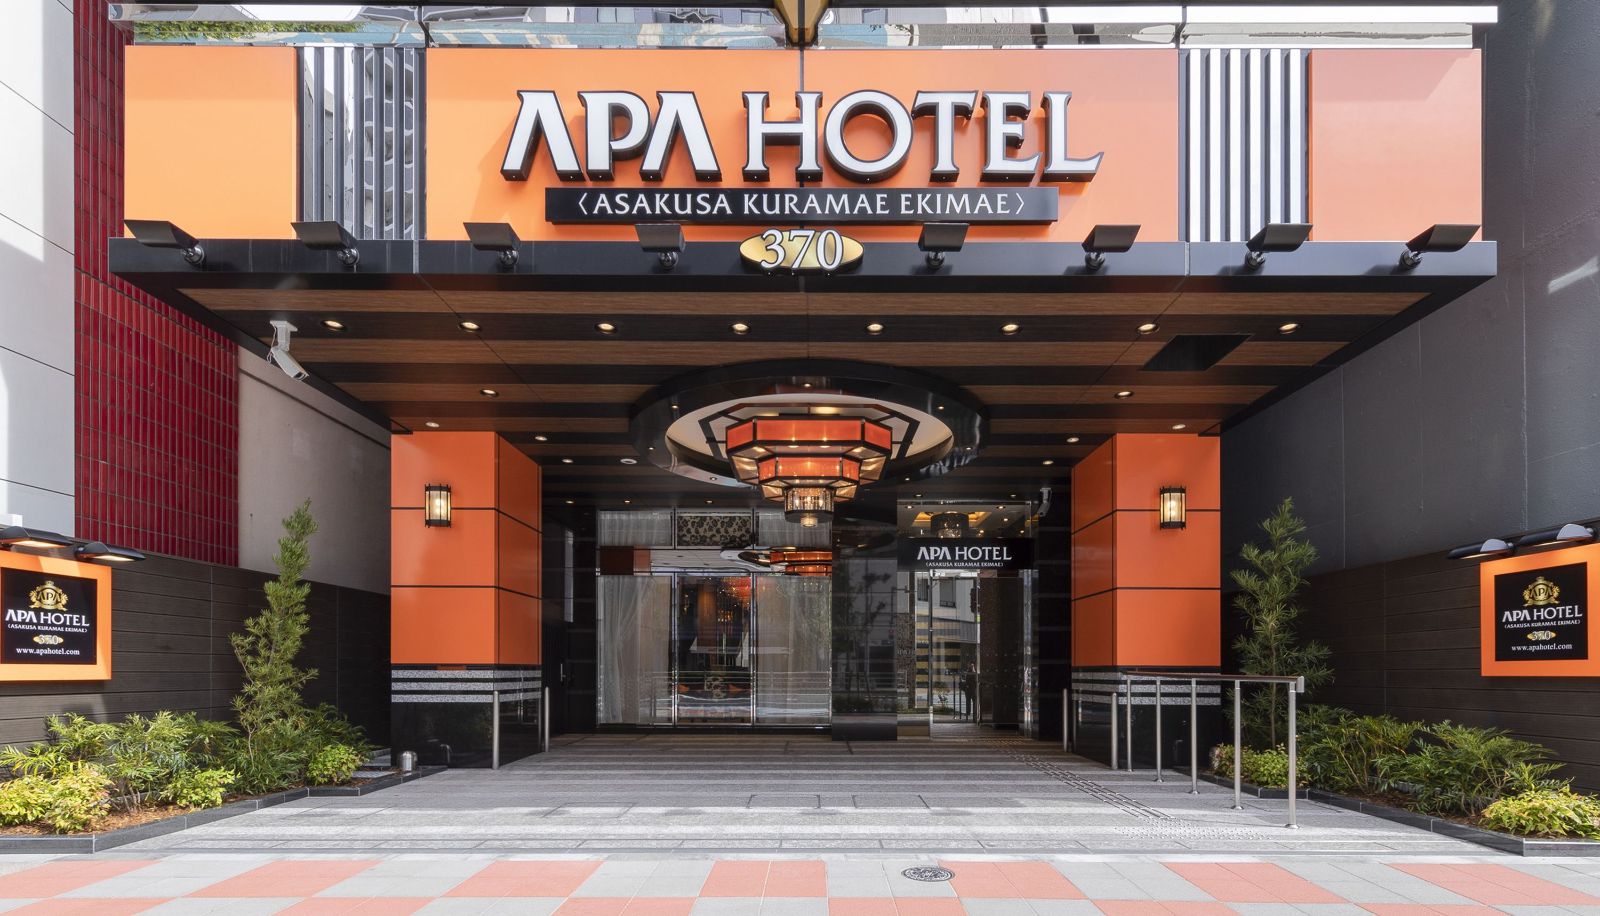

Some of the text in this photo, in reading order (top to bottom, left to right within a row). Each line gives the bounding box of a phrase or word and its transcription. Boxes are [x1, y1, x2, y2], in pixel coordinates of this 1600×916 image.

[500, 89, 1104, 182] APA HOTEL
[744, 193, 890, 214] KURAMAE
[760, 228, 844, 269] 370
[917, 546, 1012, 560] APA HOTEL
[5, 609, 89, 626] APA HOTEL
[1502, 605, 1583, 622] APA HOTEL
[16, 647, 80, 656] www.apahotel.com
[1512, 643, 1572, 652] www.apahotel.com
